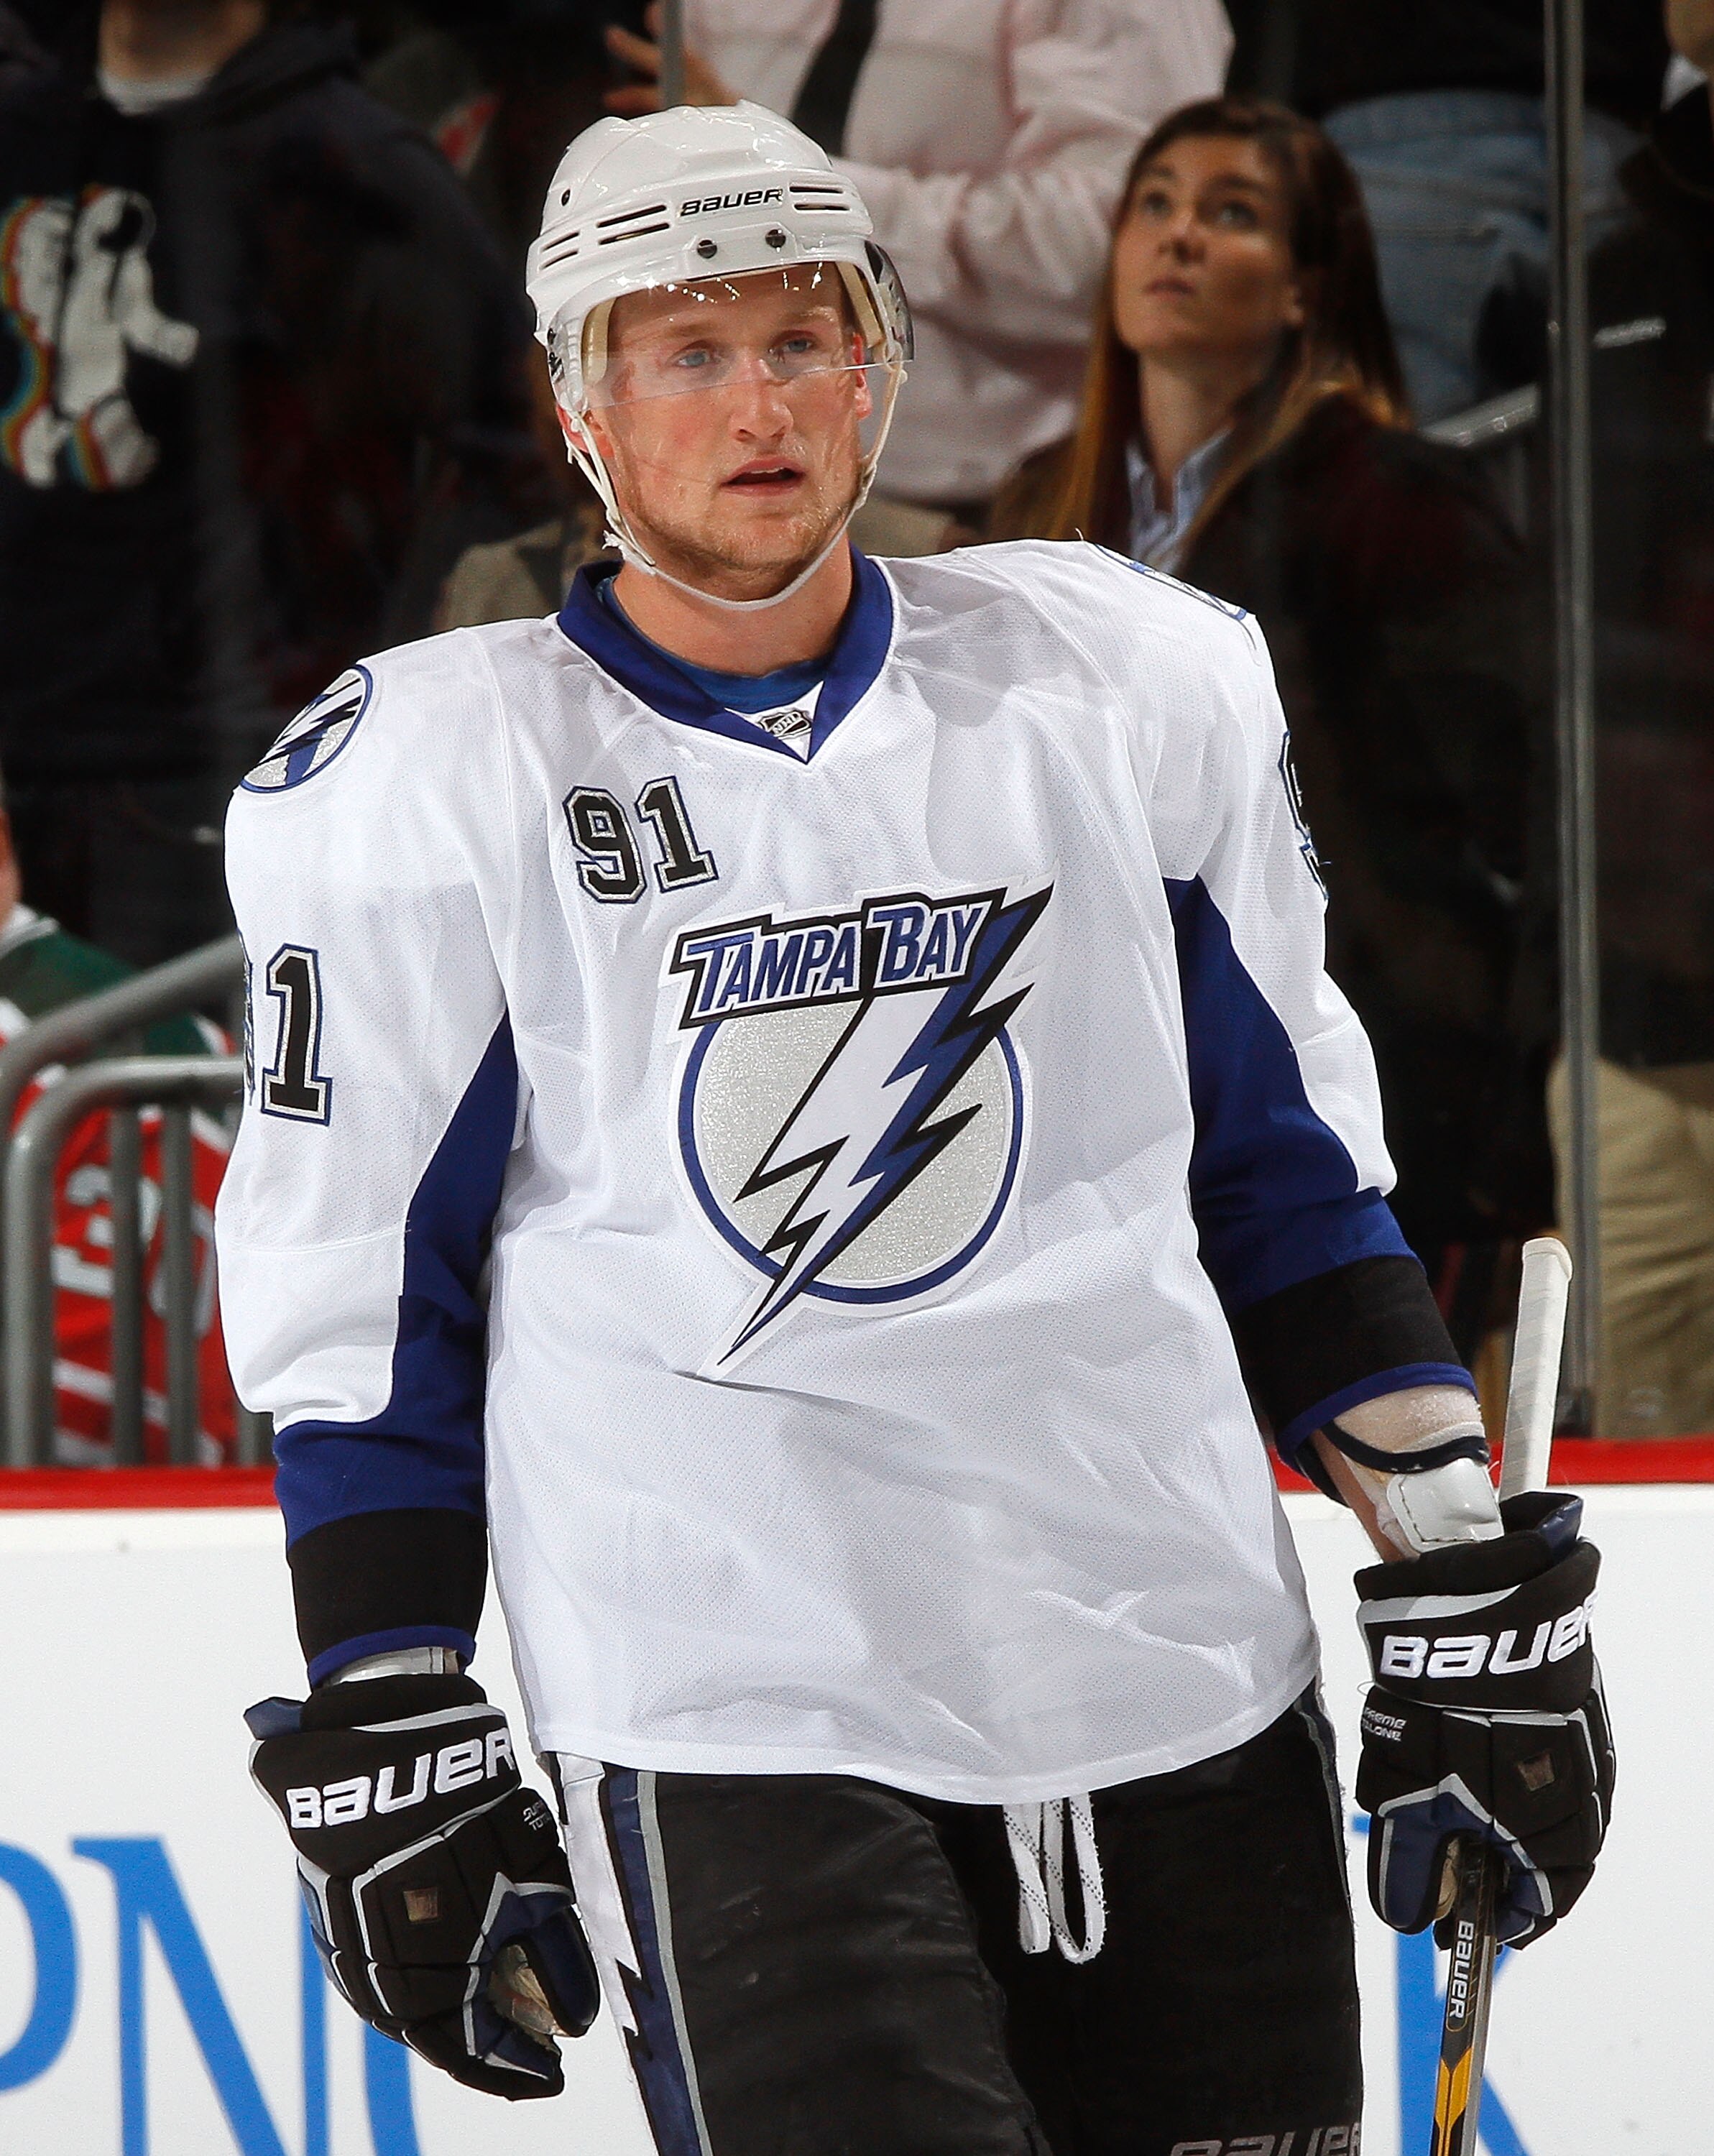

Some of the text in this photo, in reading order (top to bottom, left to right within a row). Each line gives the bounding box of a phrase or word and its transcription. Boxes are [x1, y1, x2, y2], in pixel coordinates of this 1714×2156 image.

[680, 188, 783, 216] BAUER
[562, 775, 719, 904] 91
[686, 906, 982, 1012] TAMPA BAY
[242, 938, 333, 1126] 1
[285, 1728, 517, 1830] BAUER
[1449, 1920, 1475, 2019] BAUER
